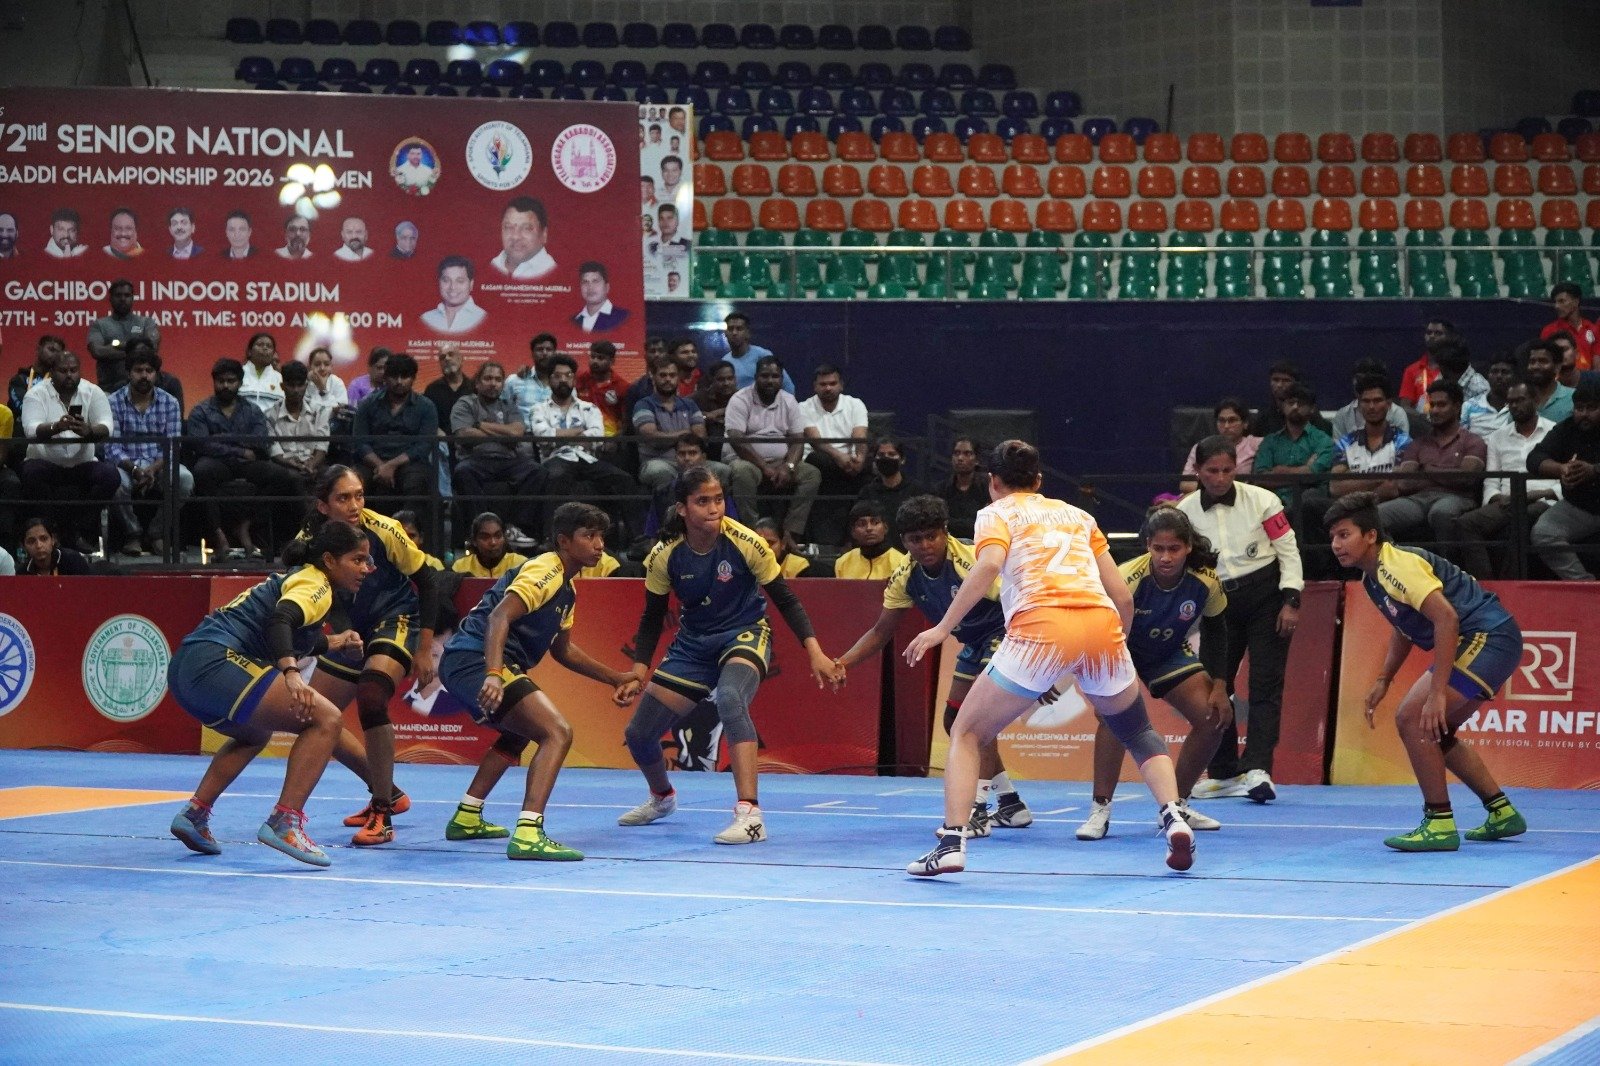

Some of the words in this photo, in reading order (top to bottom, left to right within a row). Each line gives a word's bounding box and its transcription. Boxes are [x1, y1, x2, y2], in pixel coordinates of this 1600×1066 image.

[57, 124, 176, 155] SENIOR
[186, 126, 354, 159] NATIONAL
[62, 166, 218, 186] CHAMPIONSHIP
[223, 168, 274, 188] 2026
[151, 280, 240, 302] INDOOR
[245, 281, 340, 303] STADIUM
[54, 310, 97, 327] 30TH
[192, 310, 237, 328] TIME:
[241, 311, 286, 328] 10:00
[376, 312, 403, 329] PM
[725, 525, 767, 558] KABADDI
[1042, 530, 1078, 575] 2
[88, 623, 123, 665] GOVERNMENT
[127, 622, 137, 630] OF
[141, 625, 166, 667] TELANGANA
[399, 724, 439, 732] MAHENDAR
[440, 725, 463, 733] REDDY
[1539, 710, 1600, 735] INF
[1016, 733, 1070, 742] GNANESHWAR
[1479, 738, 1491, 746] BY
[1537, 740, 1574, 748] DRIVEN
[1578, 741, 1591, 749] BY
